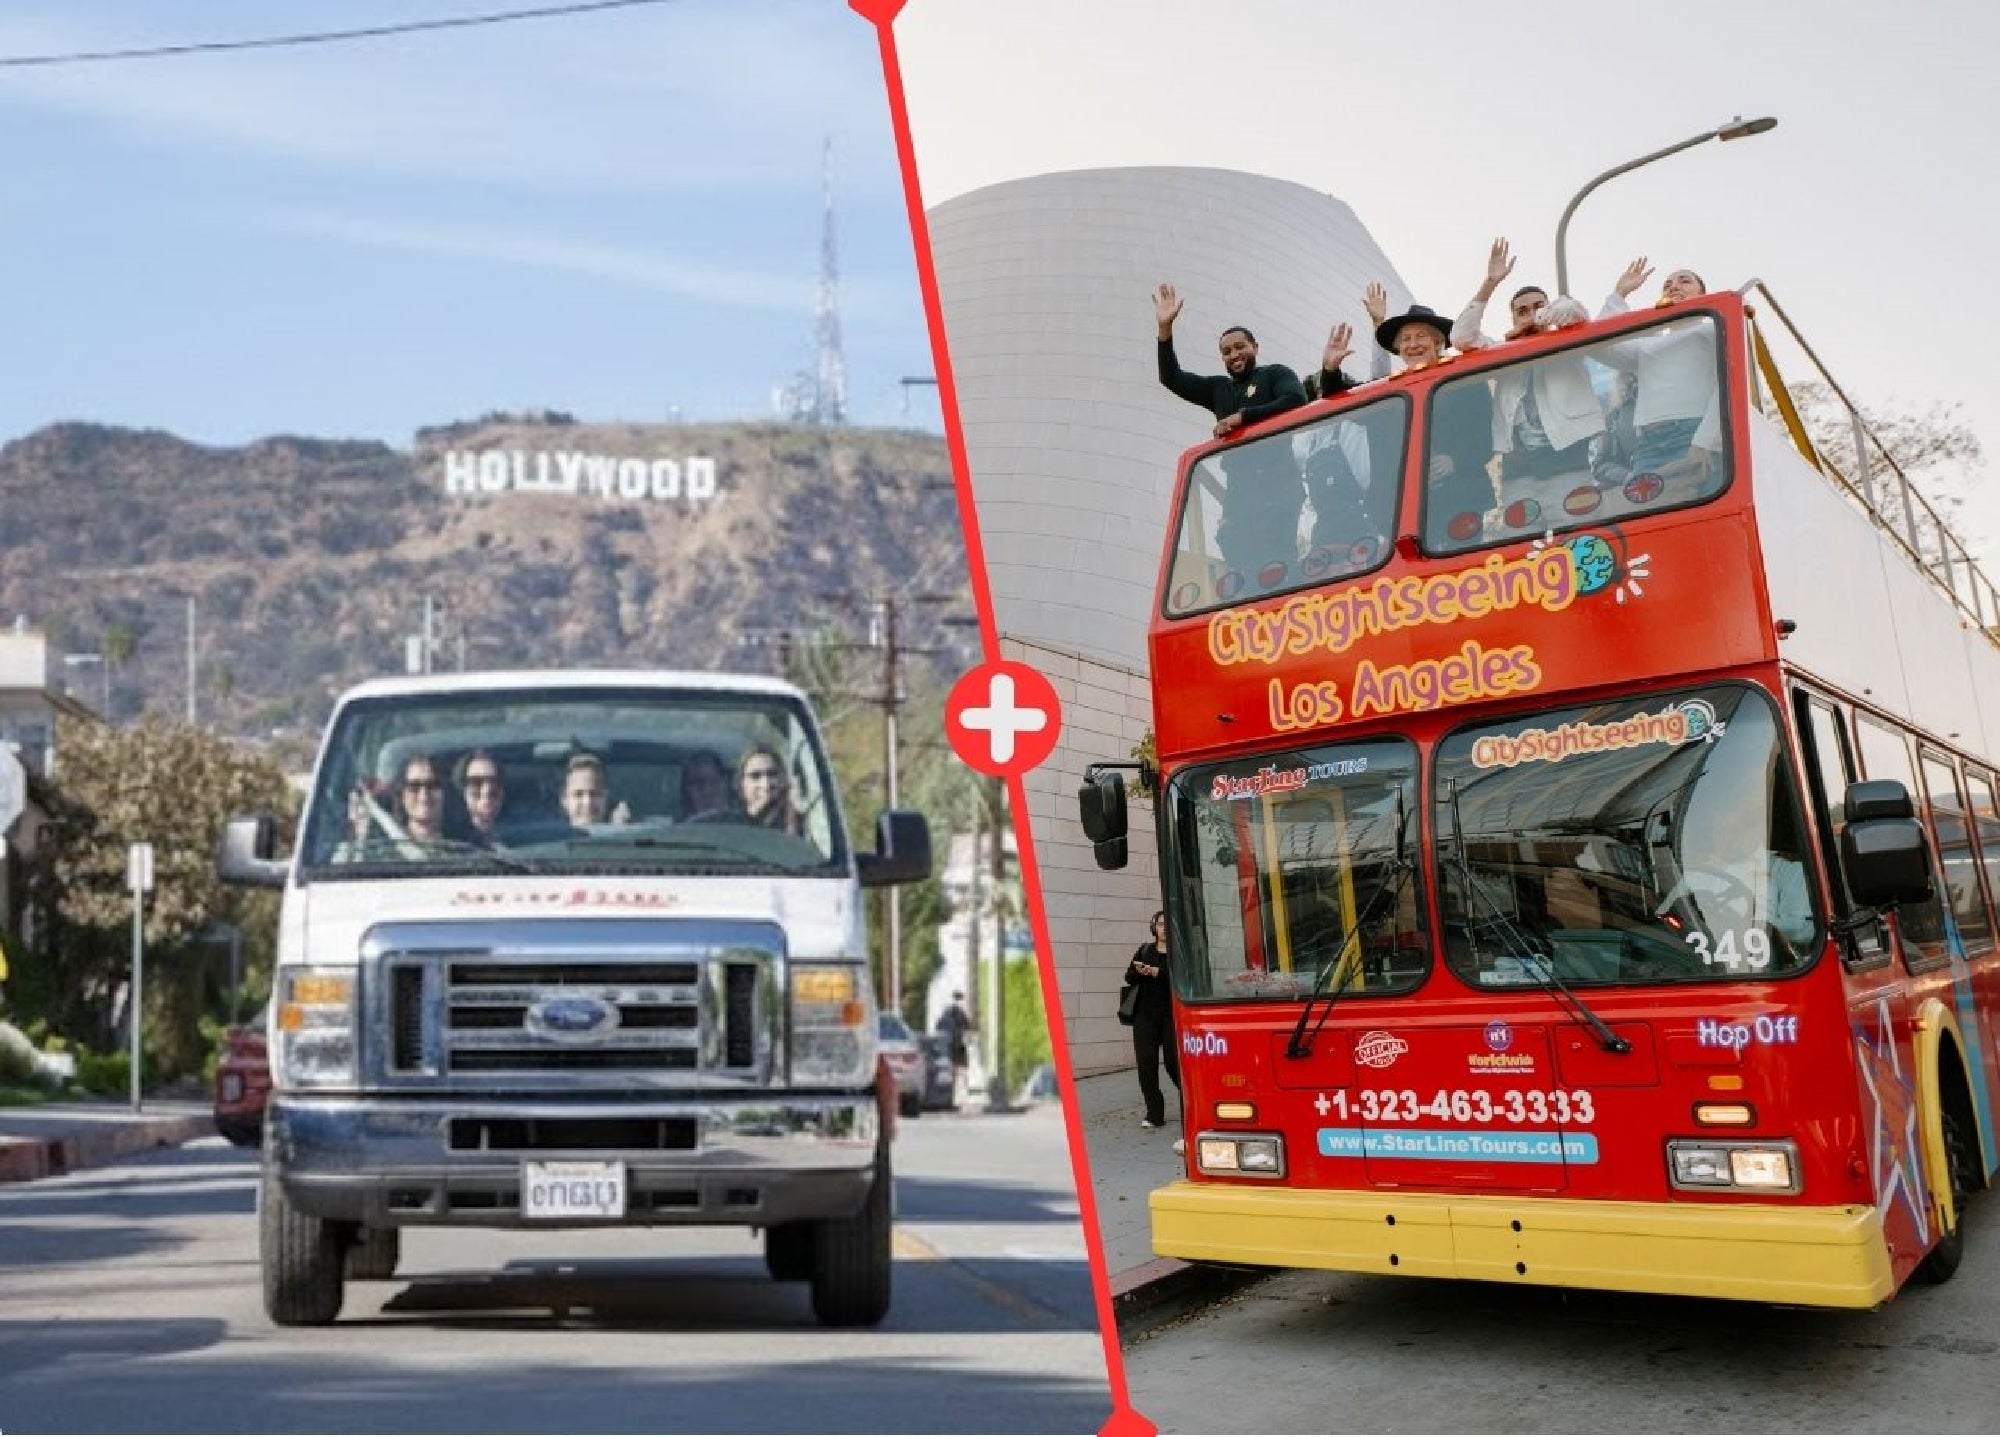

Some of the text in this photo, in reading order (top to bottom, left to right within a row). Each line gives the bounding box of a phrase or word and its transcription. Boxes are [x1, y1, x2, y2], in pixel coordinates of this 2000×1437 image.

[445, 450, 716, 501] HOLLYWOOD
[1209, 545, 1579, 666] CitySightseeing
[1269, 640, 1542, 731] Los Angeles
[1472, 712, 1686, 768] CitySightseeing
[1308, 758, 1367, 780] TOURS
[1685, 928, 1770, 968] 349
[1182, 1030, 1228, 1057] Hop On
[1699, 1016, 1797, 1047] Hop Off
[1314, 1090, 1595, 1123] +1-323-463-3333
[1328, 1133, 1585, 1155] www.StarLineTours.com
